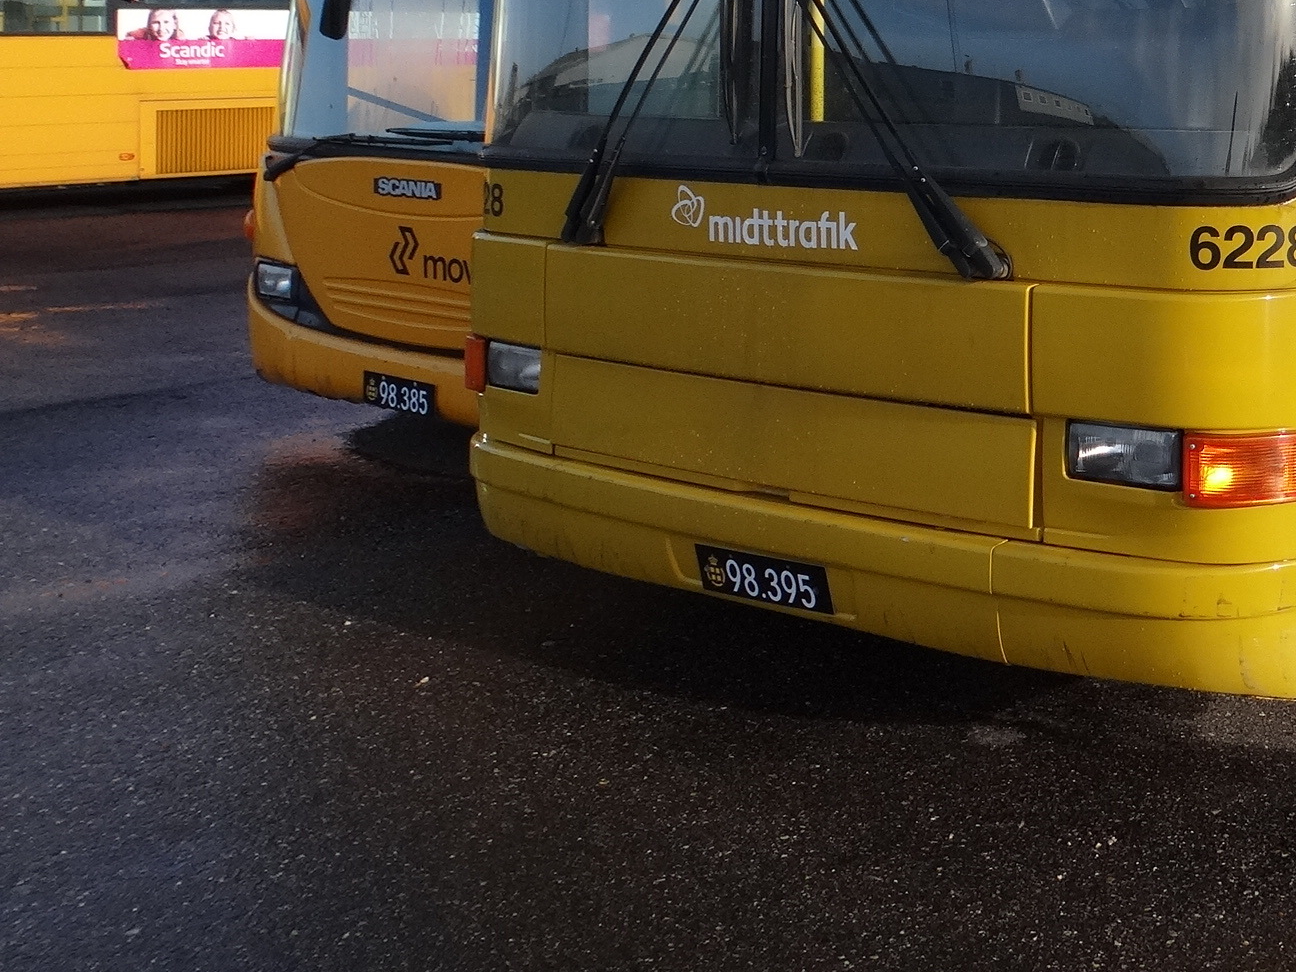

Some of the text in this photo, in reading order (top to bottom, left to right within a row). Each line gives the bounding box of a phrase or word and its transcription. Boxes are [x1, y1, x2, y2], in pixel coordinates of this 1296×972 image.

[159, 42, 226, 58] Scandic
[378, 178, 437, 199] SCANIA
[709, 208, 859, 250] midttrafik
[380, 381, 428, 415] 98.385
[726, 559, 816, 608] 98.395
